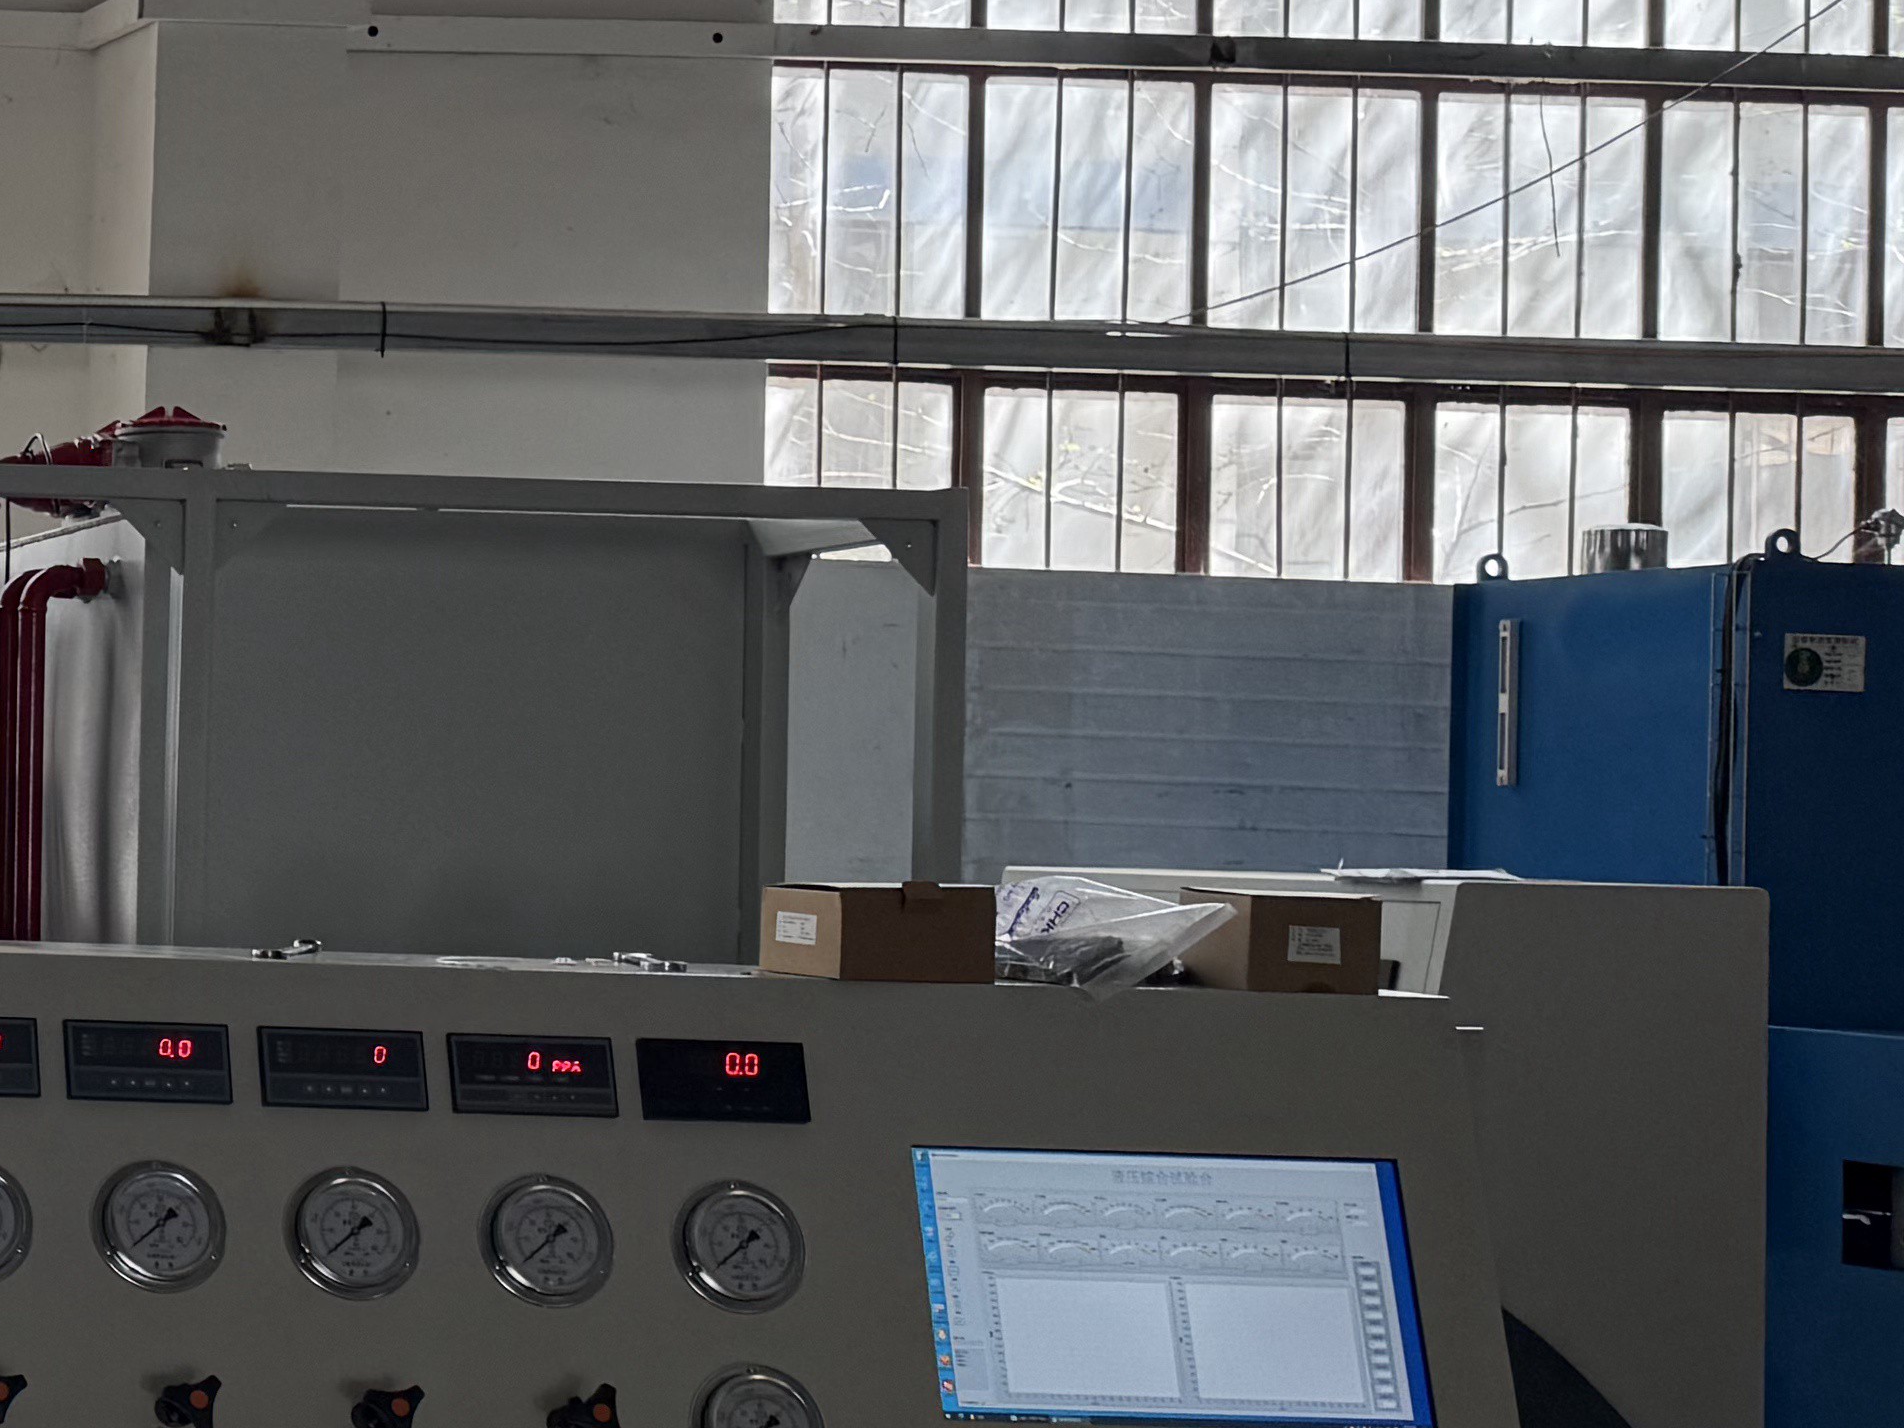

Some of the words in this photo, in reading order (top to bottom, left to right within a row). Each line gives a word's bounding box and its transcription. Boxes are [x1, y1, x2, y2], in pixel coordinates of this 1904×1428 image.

[159, 1037, 194, 1061] 0.0
[373, 1045, 388, 1066] 0
[527, 1050, 542, 1071] 0
[725, 1052, 761, 1078] 0.0
